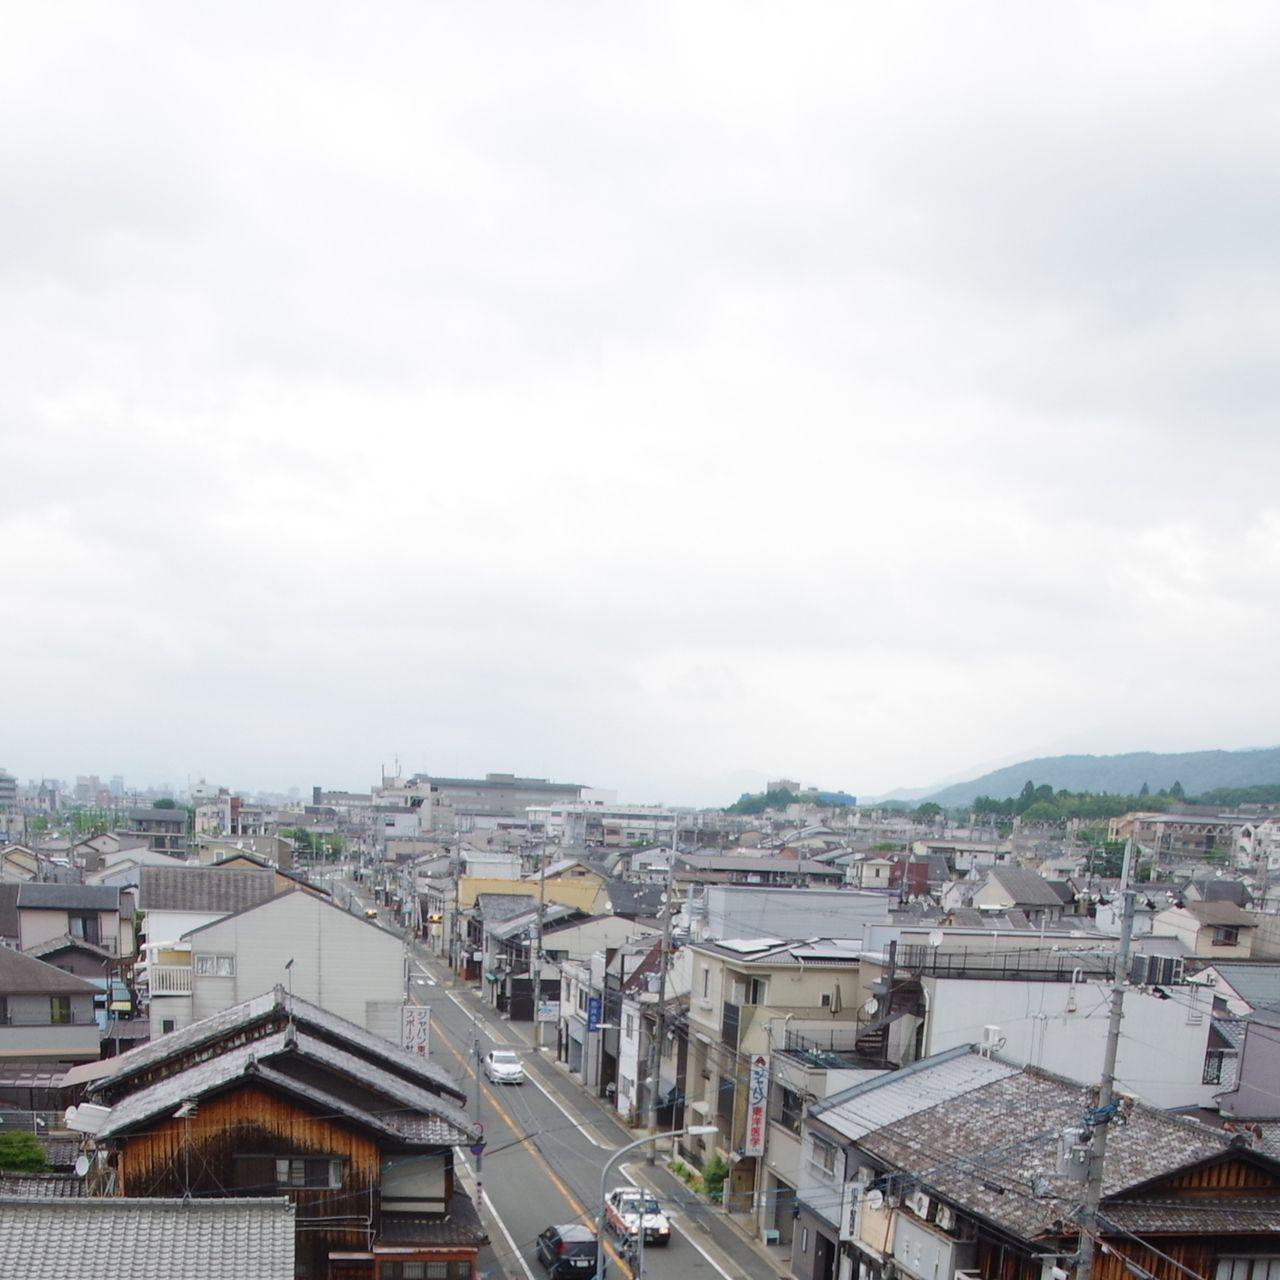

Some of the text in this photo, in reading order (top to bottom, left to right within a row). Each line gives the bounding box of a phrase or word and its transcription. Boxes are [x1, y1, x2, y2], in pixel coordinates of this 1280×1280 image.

[749, 1066, 767, 1147] ジャパン東洋医学
